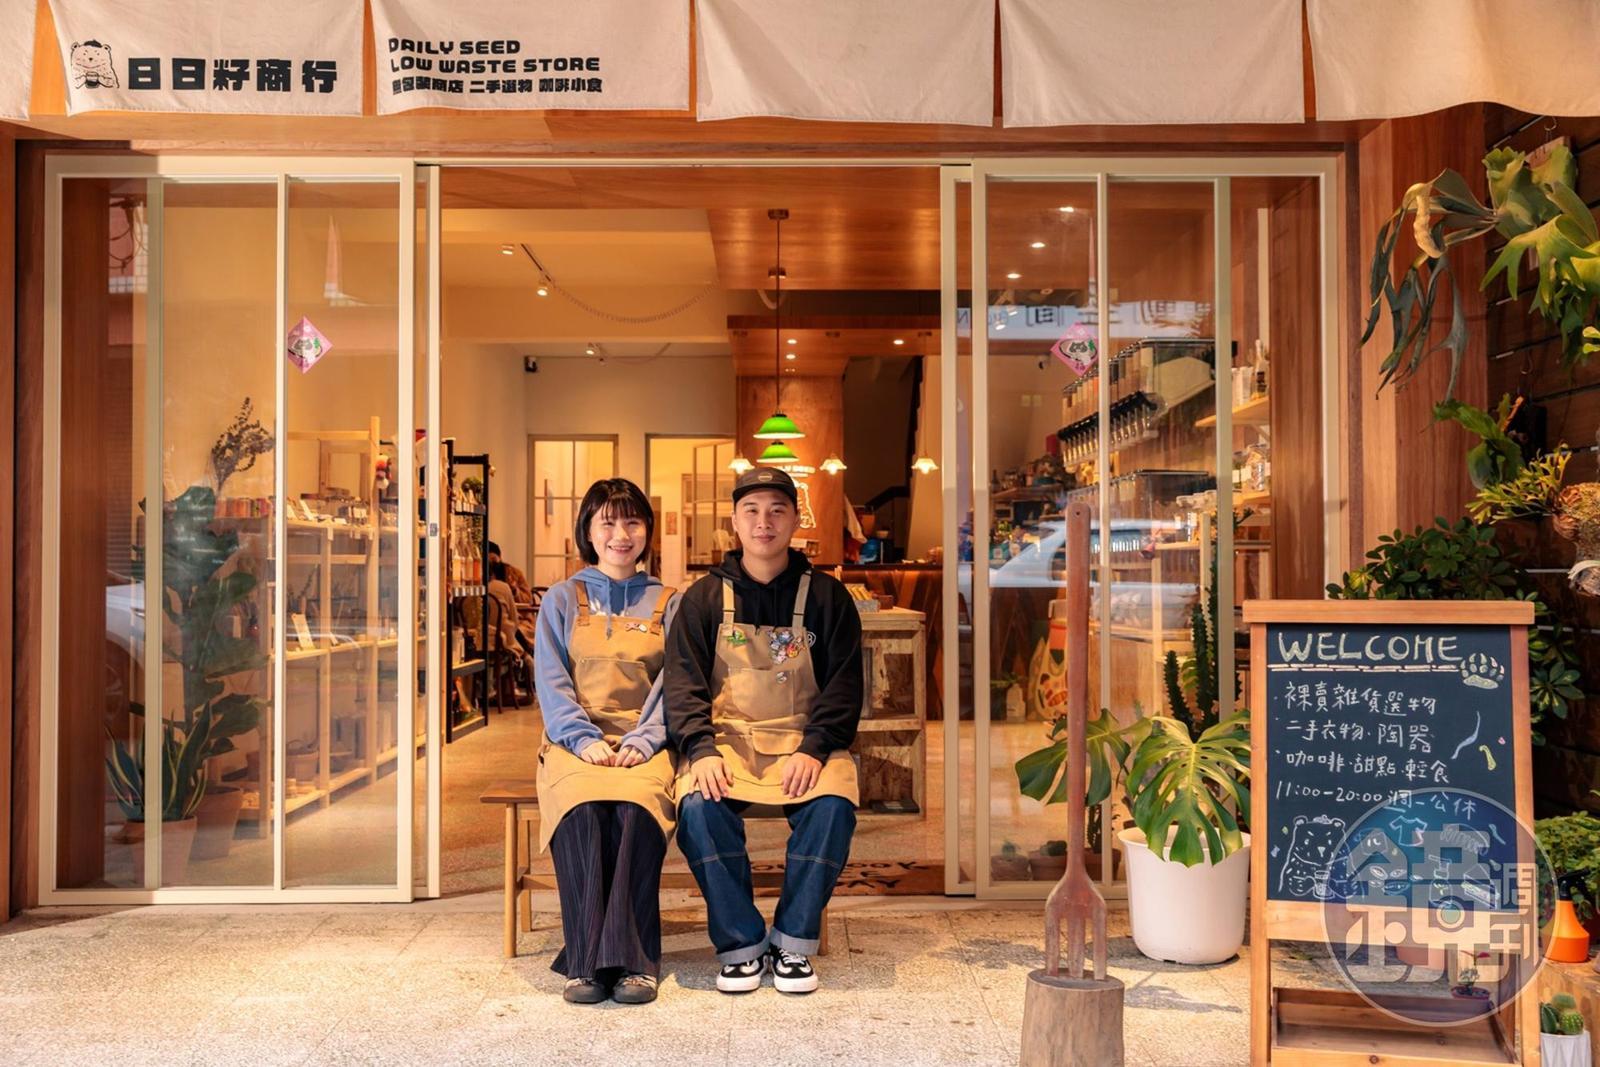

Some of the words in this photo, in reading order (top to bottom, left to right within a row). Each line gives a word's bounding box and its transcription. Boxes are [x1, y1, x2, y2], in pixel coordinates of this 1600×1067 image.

[388, 38, 454, 54] DAILY
[460, 40, 521, 54] SEED
[128, 57, 337, 93] 日日籽商行
[390, 56, 433, 73] LOW
[439, 59, 516, 74] WASTE
[523, 57, 600, 72] STORE
[1278, 632, 1463, 663] WELCOME
[1284, 680, 1437, 717] 裸賣雜貨選物
[1275, 780, 1383, 804] 11:00-20:00
